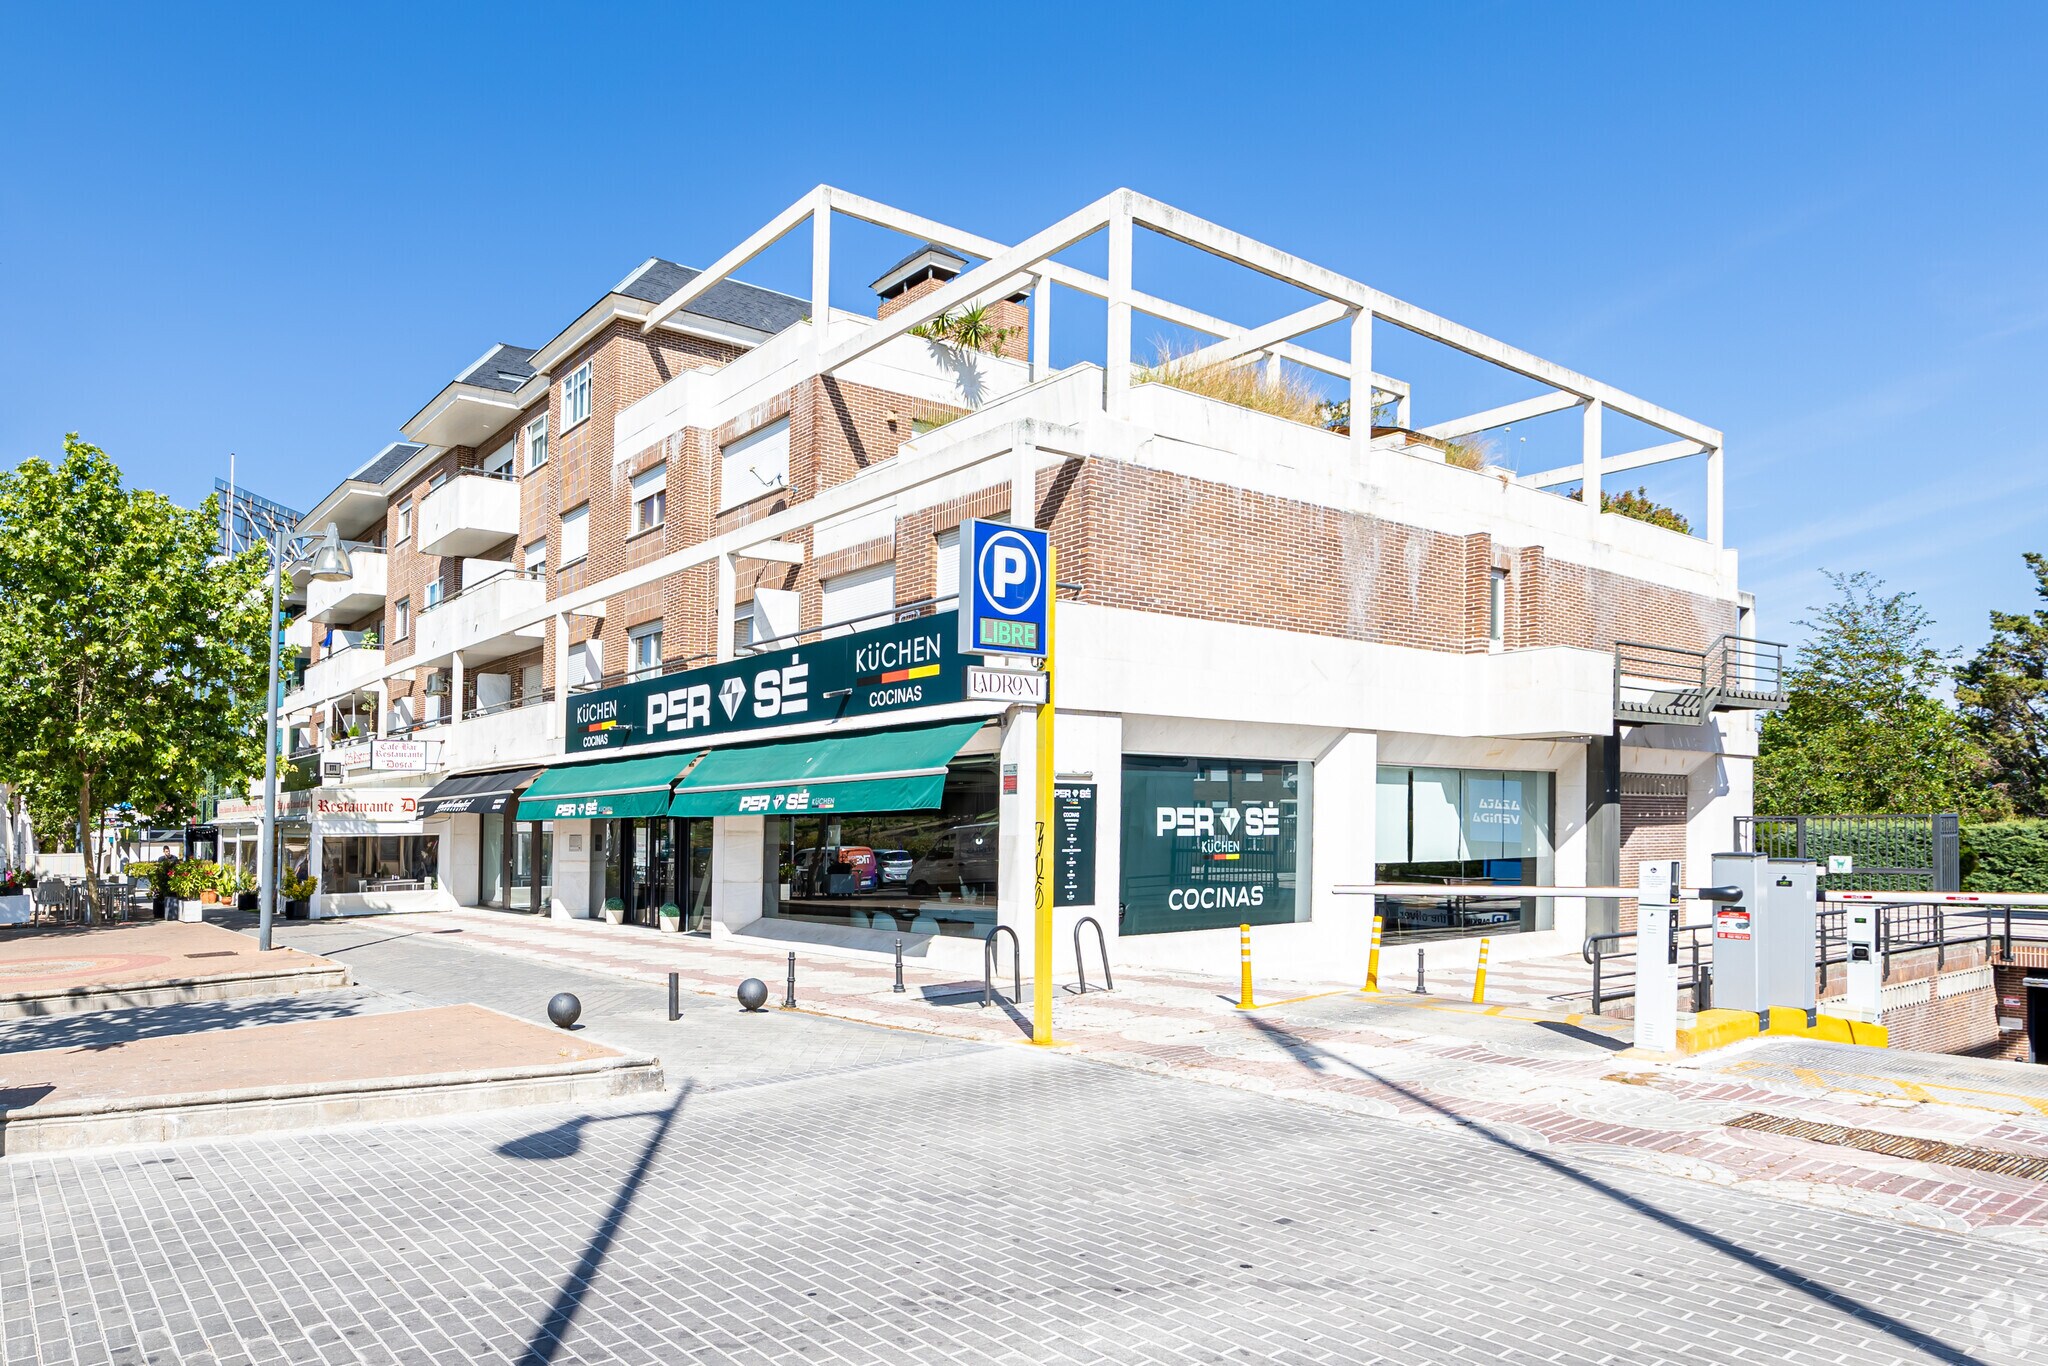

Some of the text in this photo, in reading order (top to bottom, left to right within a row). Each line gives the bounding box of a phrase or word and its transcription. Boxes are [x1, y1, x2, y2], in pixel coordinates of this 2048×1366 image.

[994, 545, 1026, 598] P
[981, 620, 1036, 647] LIBRE
[647, 653, 809, 735] PER SÉ
[869, 685, 922, 707] COCINAS
[583, 733, 609, 748] COCINAS
[738, 794, 770, 812] PER
[785, 789, 810, 810] SÉ
[1054, 789, 1071, 798] PER
[317, 799, 394, 813] Restaurante
[555, 803, 576, 817] PER
[1157, 801, 1280, 836] PER SÉ
[1168, 885, 1264, 911] COCINAS
